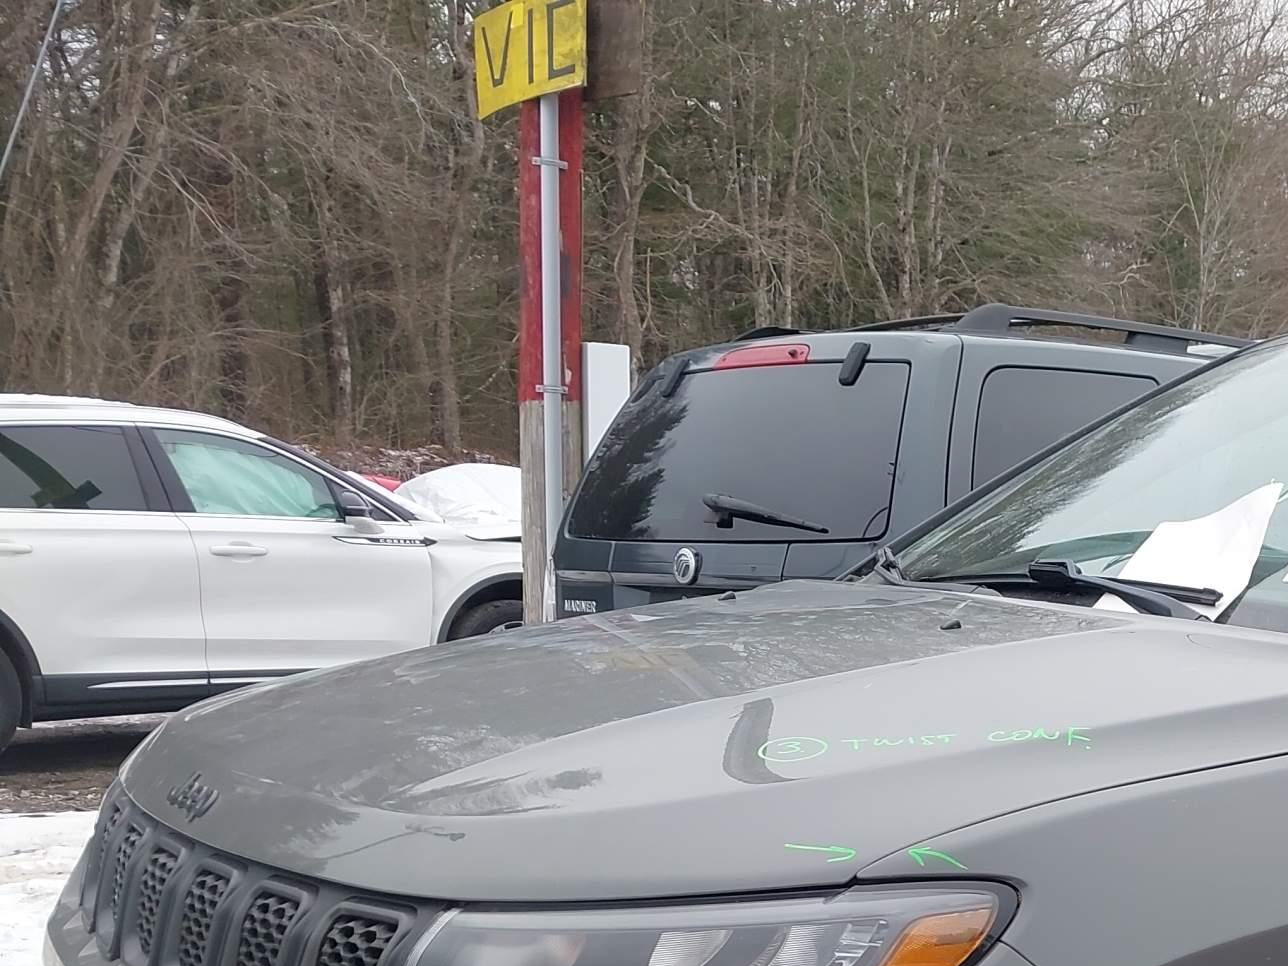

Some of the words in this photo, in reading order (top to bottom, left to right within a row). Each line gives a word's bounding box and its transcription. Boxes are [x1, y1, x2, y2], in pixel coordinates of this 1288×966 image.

[481, 0, 576, 88] VIC
[564, 599, 597, 613] MARINER
[840, 733, 957, 750] TWIST
